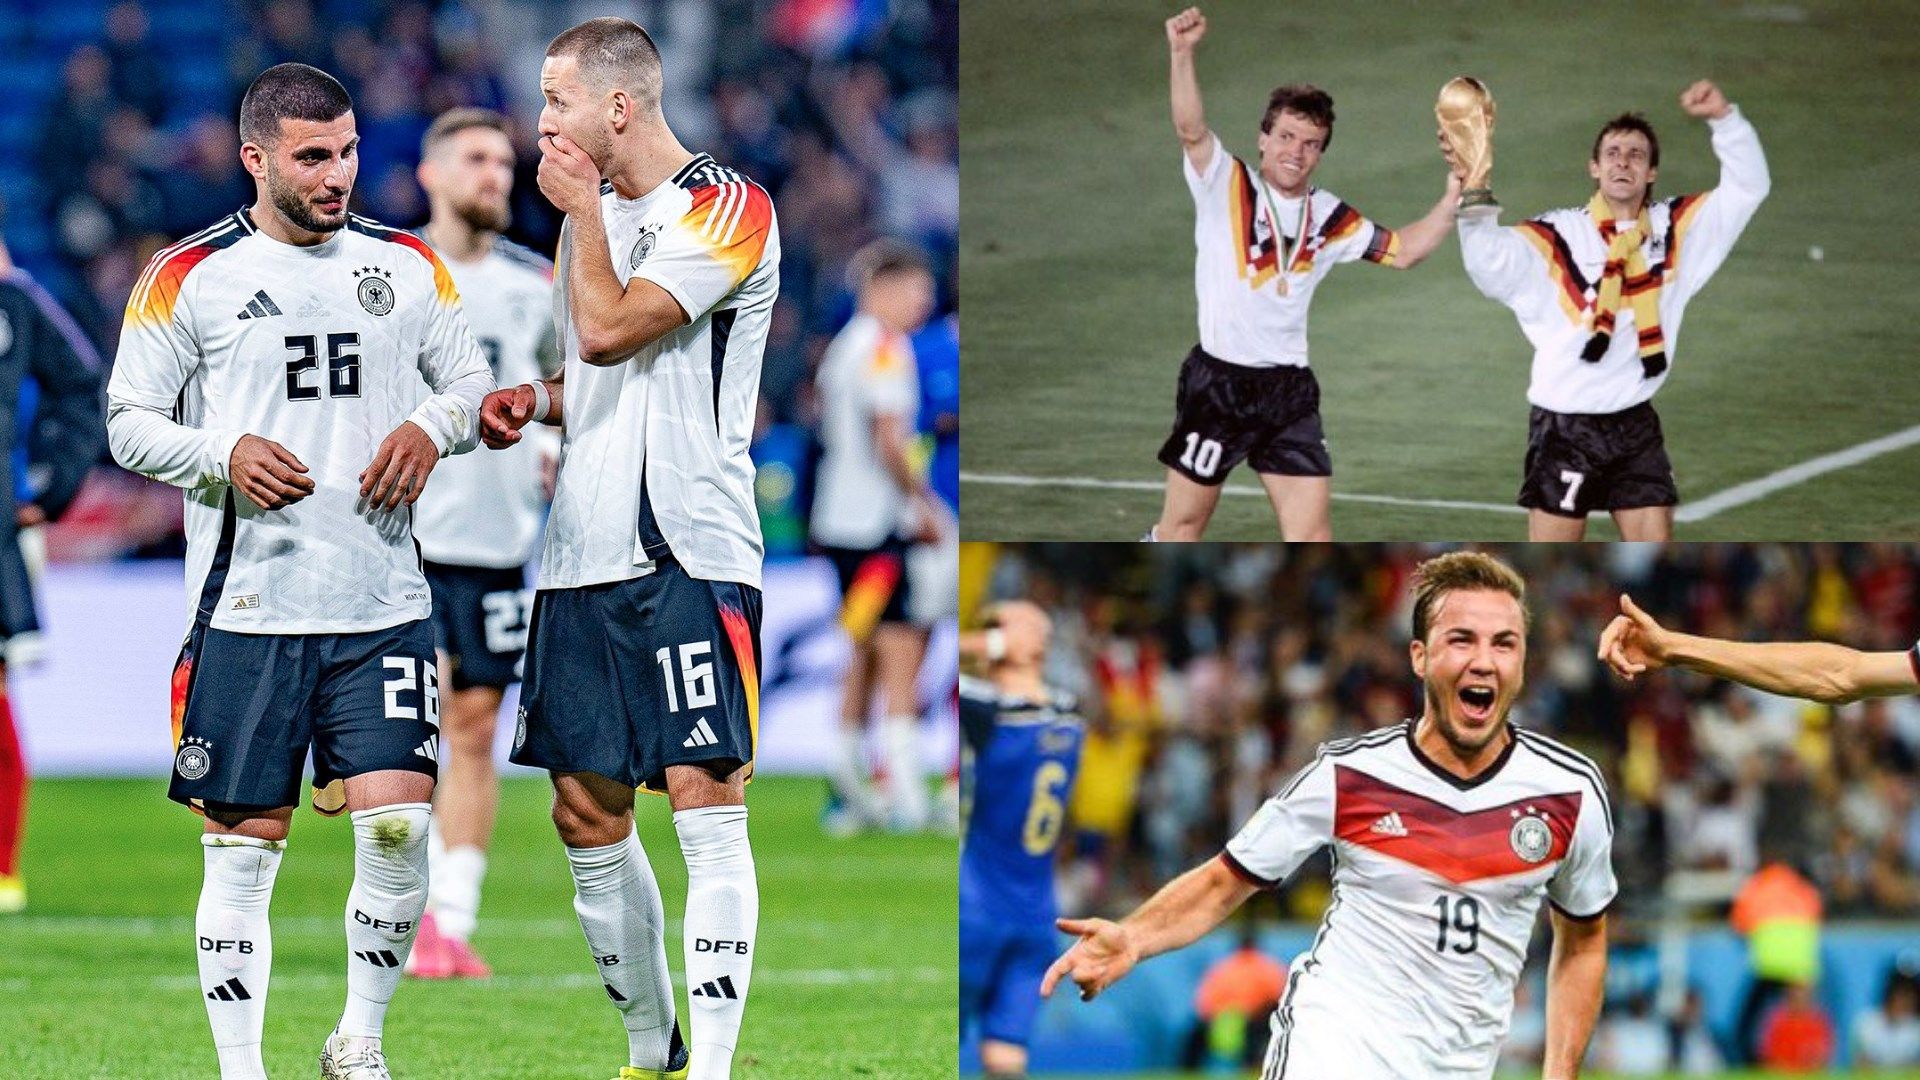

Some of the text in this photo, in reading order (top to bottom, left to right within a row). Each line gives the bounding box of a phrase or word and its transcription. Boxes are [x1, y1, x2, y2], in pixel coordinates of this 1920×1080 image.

[285, 333, 361, 401] 26
[1180, 432, 1222, 477] 10
[1559, 470, 1584, 510] 7
[383, 657, 440, 729] 26
[655, 641, 717, 712] 16
[1024, 761, 1067, 855] 6
[199, 936, 254, 955] DFB
[354, 908, 412, 934] DFB
[695, 938, 748, 955] DFB
[1435, 895, 1486, 955] 19
